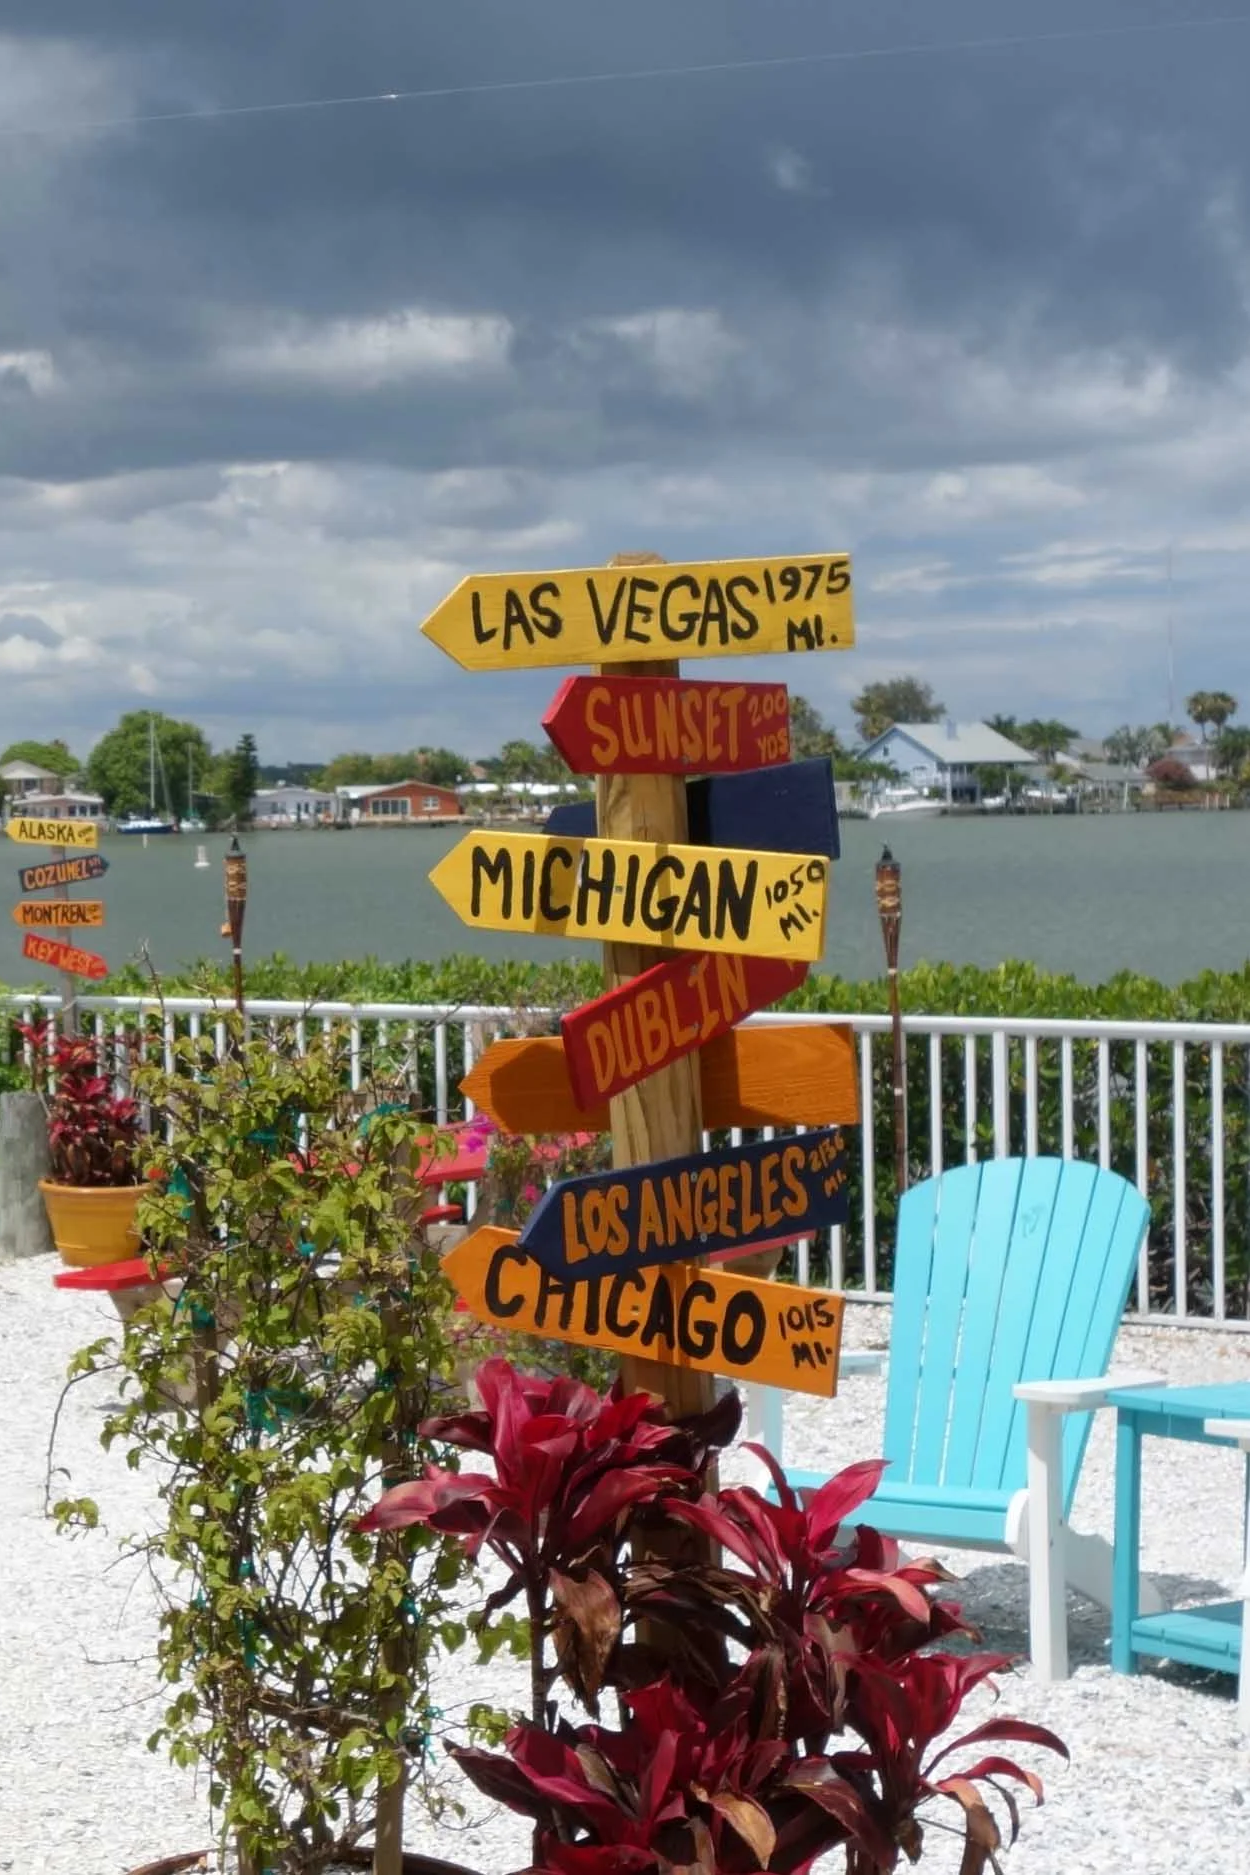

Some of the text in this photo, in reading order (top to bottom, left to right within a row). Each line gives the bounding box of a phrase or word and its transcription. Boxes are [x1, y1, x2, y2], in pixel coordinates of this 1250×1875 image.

[763, 560, 850, 604] 1975
[471, 574, 760, 650] LAS VEGAS
[787, 613, 838, 652] MI.
[585, 686, 747, 767] SUNSET
[749, 689, 787, 724] 200
[757, 731, 788, 764] YDS
[18, 820, 76, 844] ALASKA
[23, 859, 90, 890] COZUMEL
[470, 845, 758, 941] MICHIGAN
[765, 859, 825, 909] 1050
[779, 902, 820, 941] MI.
[27, 939, 58, 963] KEY
[58, 946, 92, 976] WEST
[586, 952, 748, 1092] DUBLIN
[563, 1145, 808, 1265] LOS ANGELES
[485, 1243, 766, 1366] CHICAGO
[779, 1299, 835, 1340] 1015
